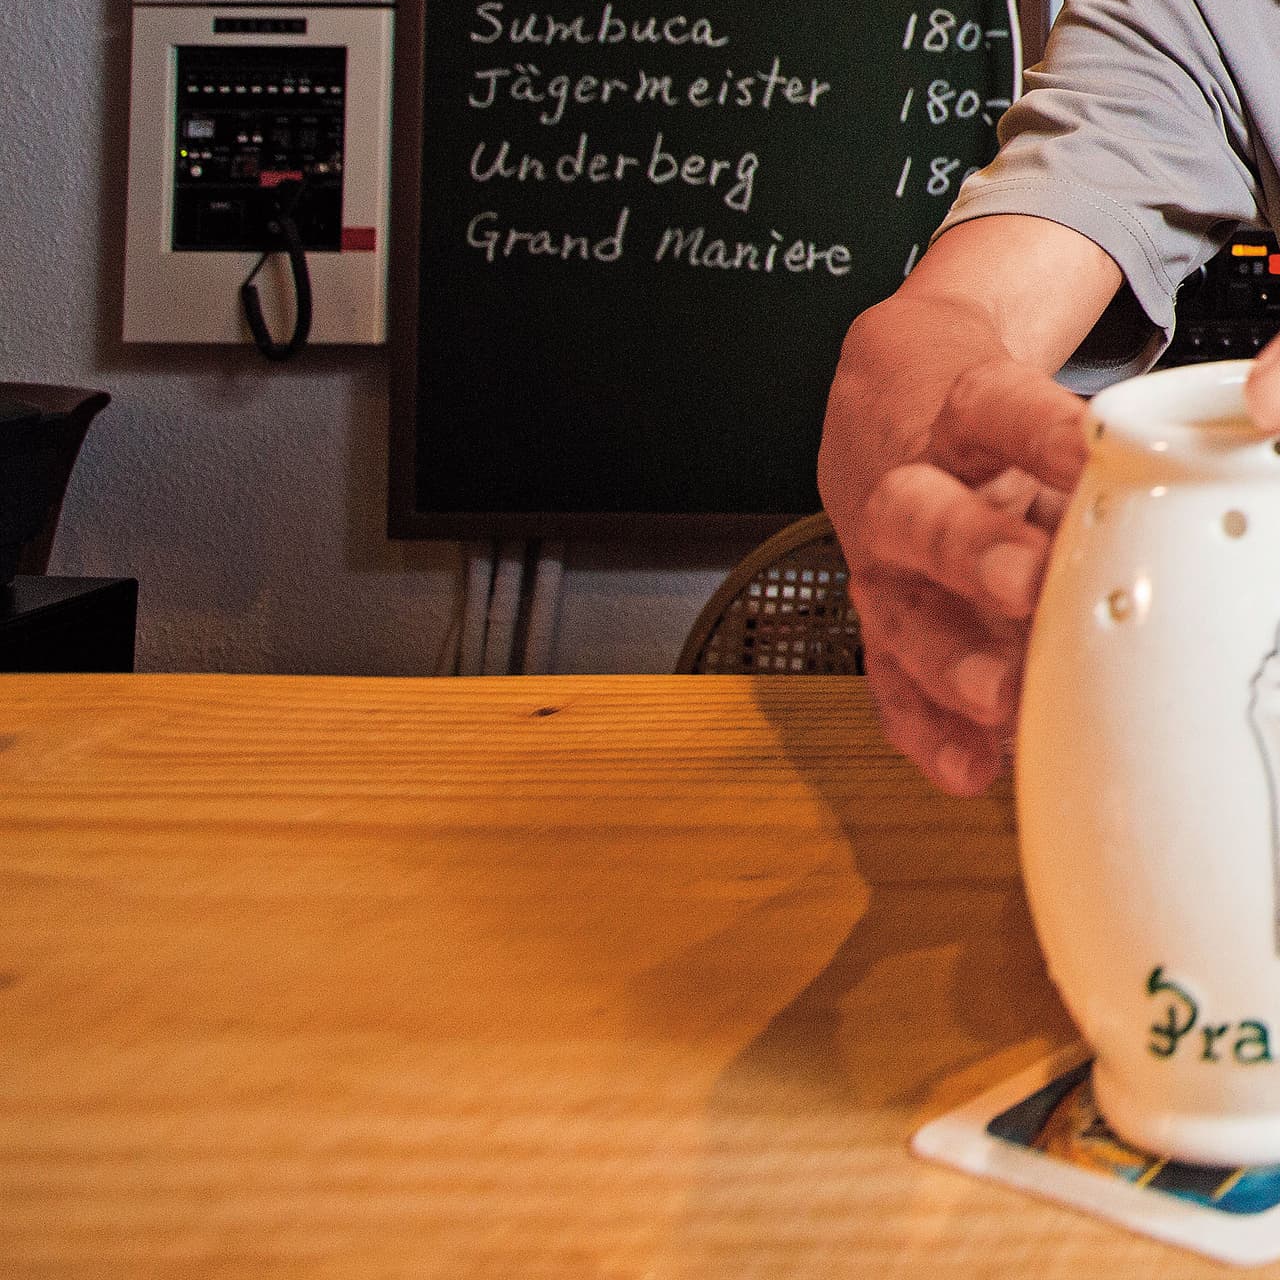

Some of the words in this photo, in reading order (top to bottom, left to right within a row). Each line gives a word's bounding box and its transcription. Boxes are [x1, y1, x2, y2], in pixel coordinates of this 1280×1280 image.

[470, 3, 728, 48] Sumbuca
[468, 56, 830, 125] Jägermeister
[469, 132, 760, 213] Underberg
[466, 207, 630, 263] Grand
